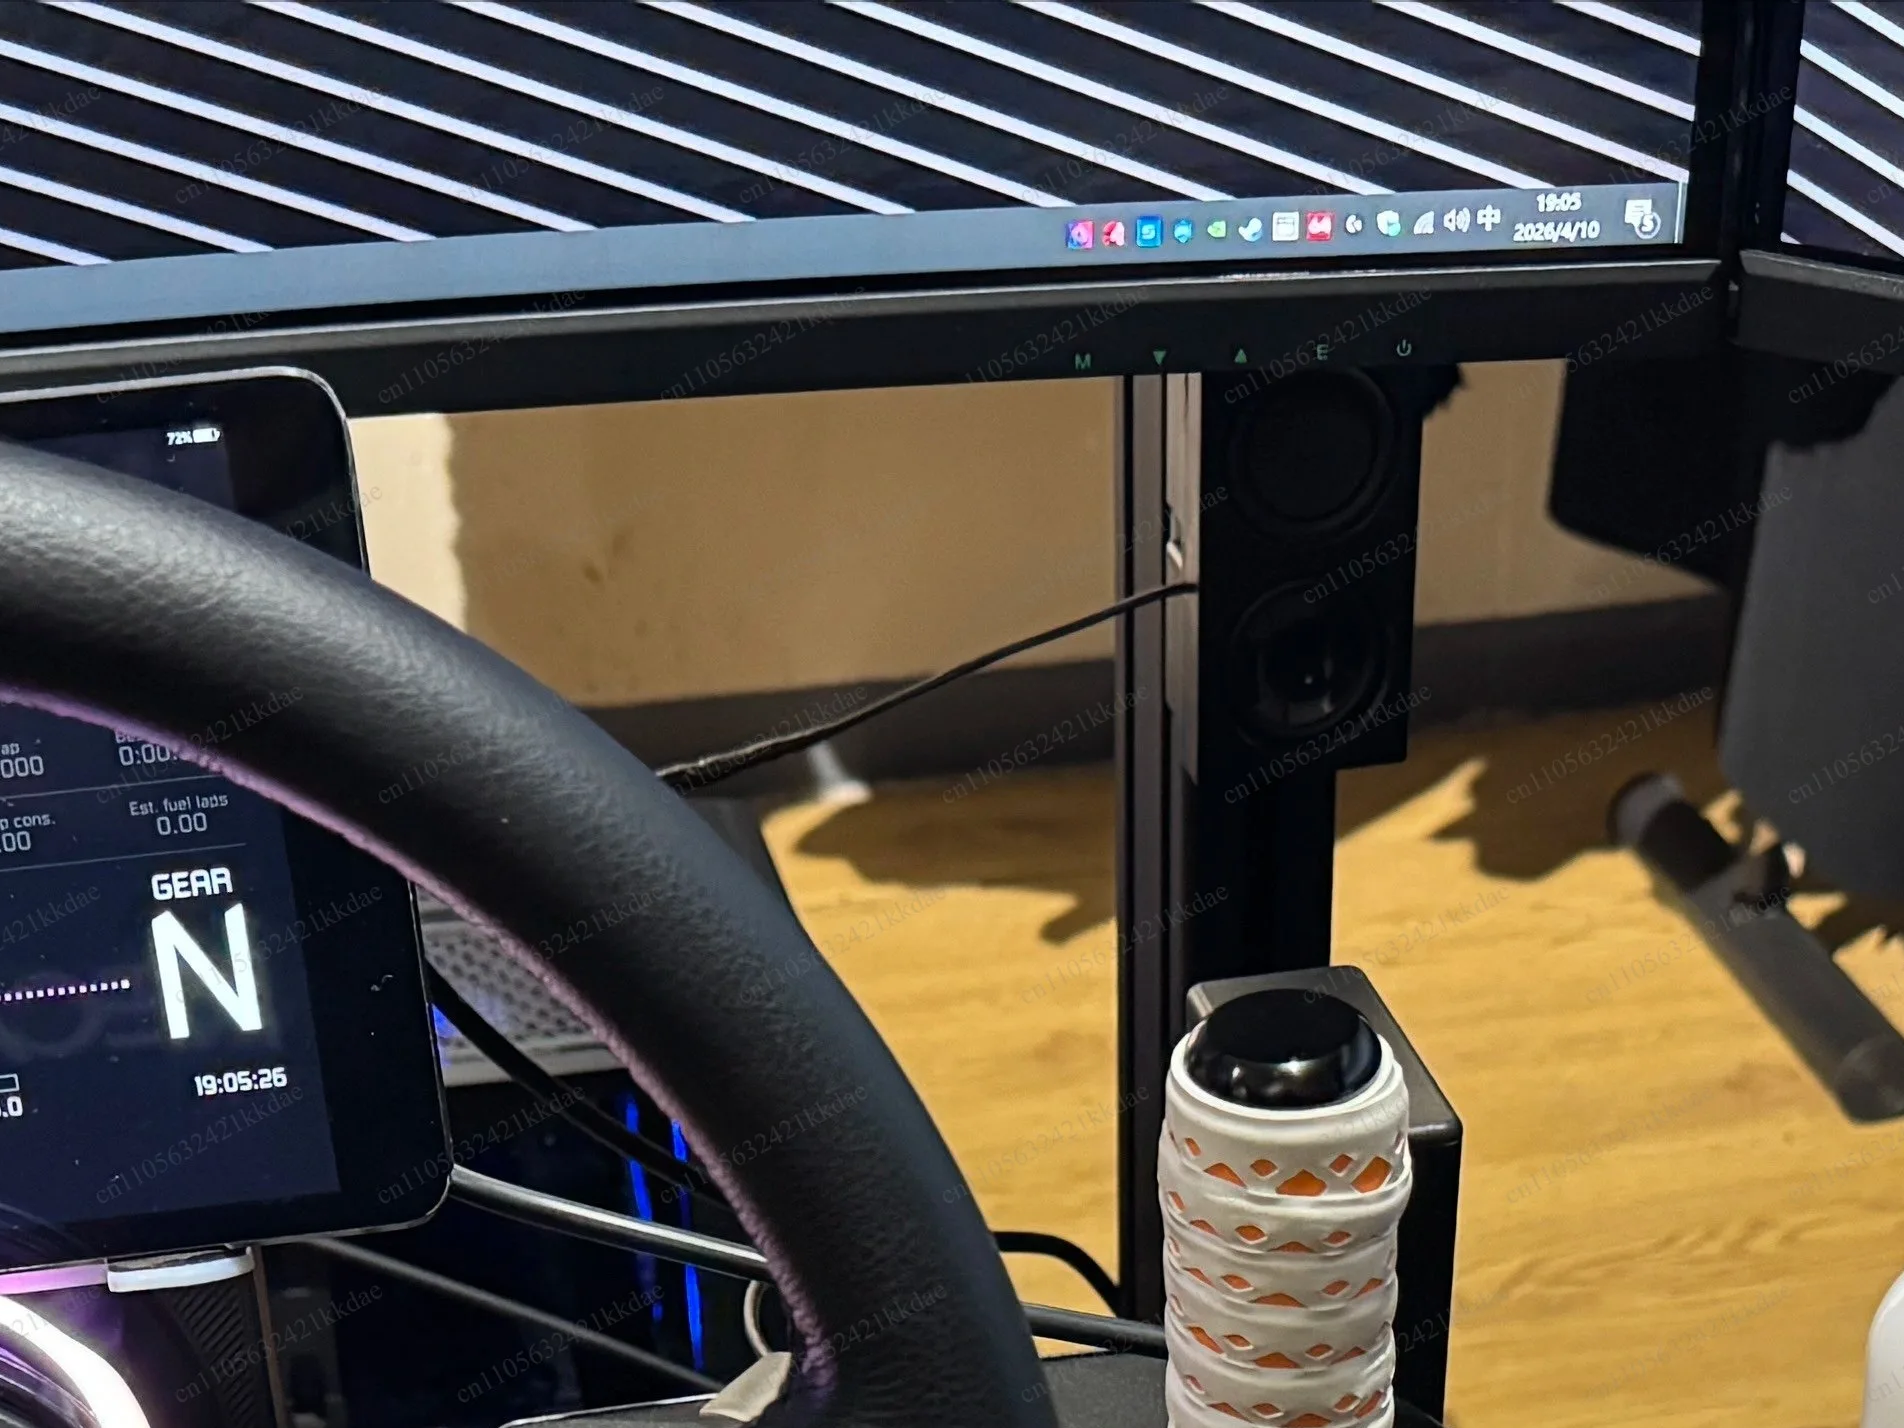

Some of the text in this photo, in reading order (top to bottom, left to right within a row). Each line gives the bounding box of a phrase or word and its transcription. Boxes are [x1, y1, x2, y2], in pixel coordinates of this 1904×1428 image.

[1477, 203, 1501, 232] 中
[1513, 219, 1600, 243] 2026/4/10
[129, 794, 229, 816] Est. fuel laps
[14, 813, 56, 830] cons.
[156, 812, 208, 836] 0.00
[151, 867, 234, 900] GEAR
[151, 903, 262, 1039] N
[194, 1066, 288, 1097] 19:05:26
